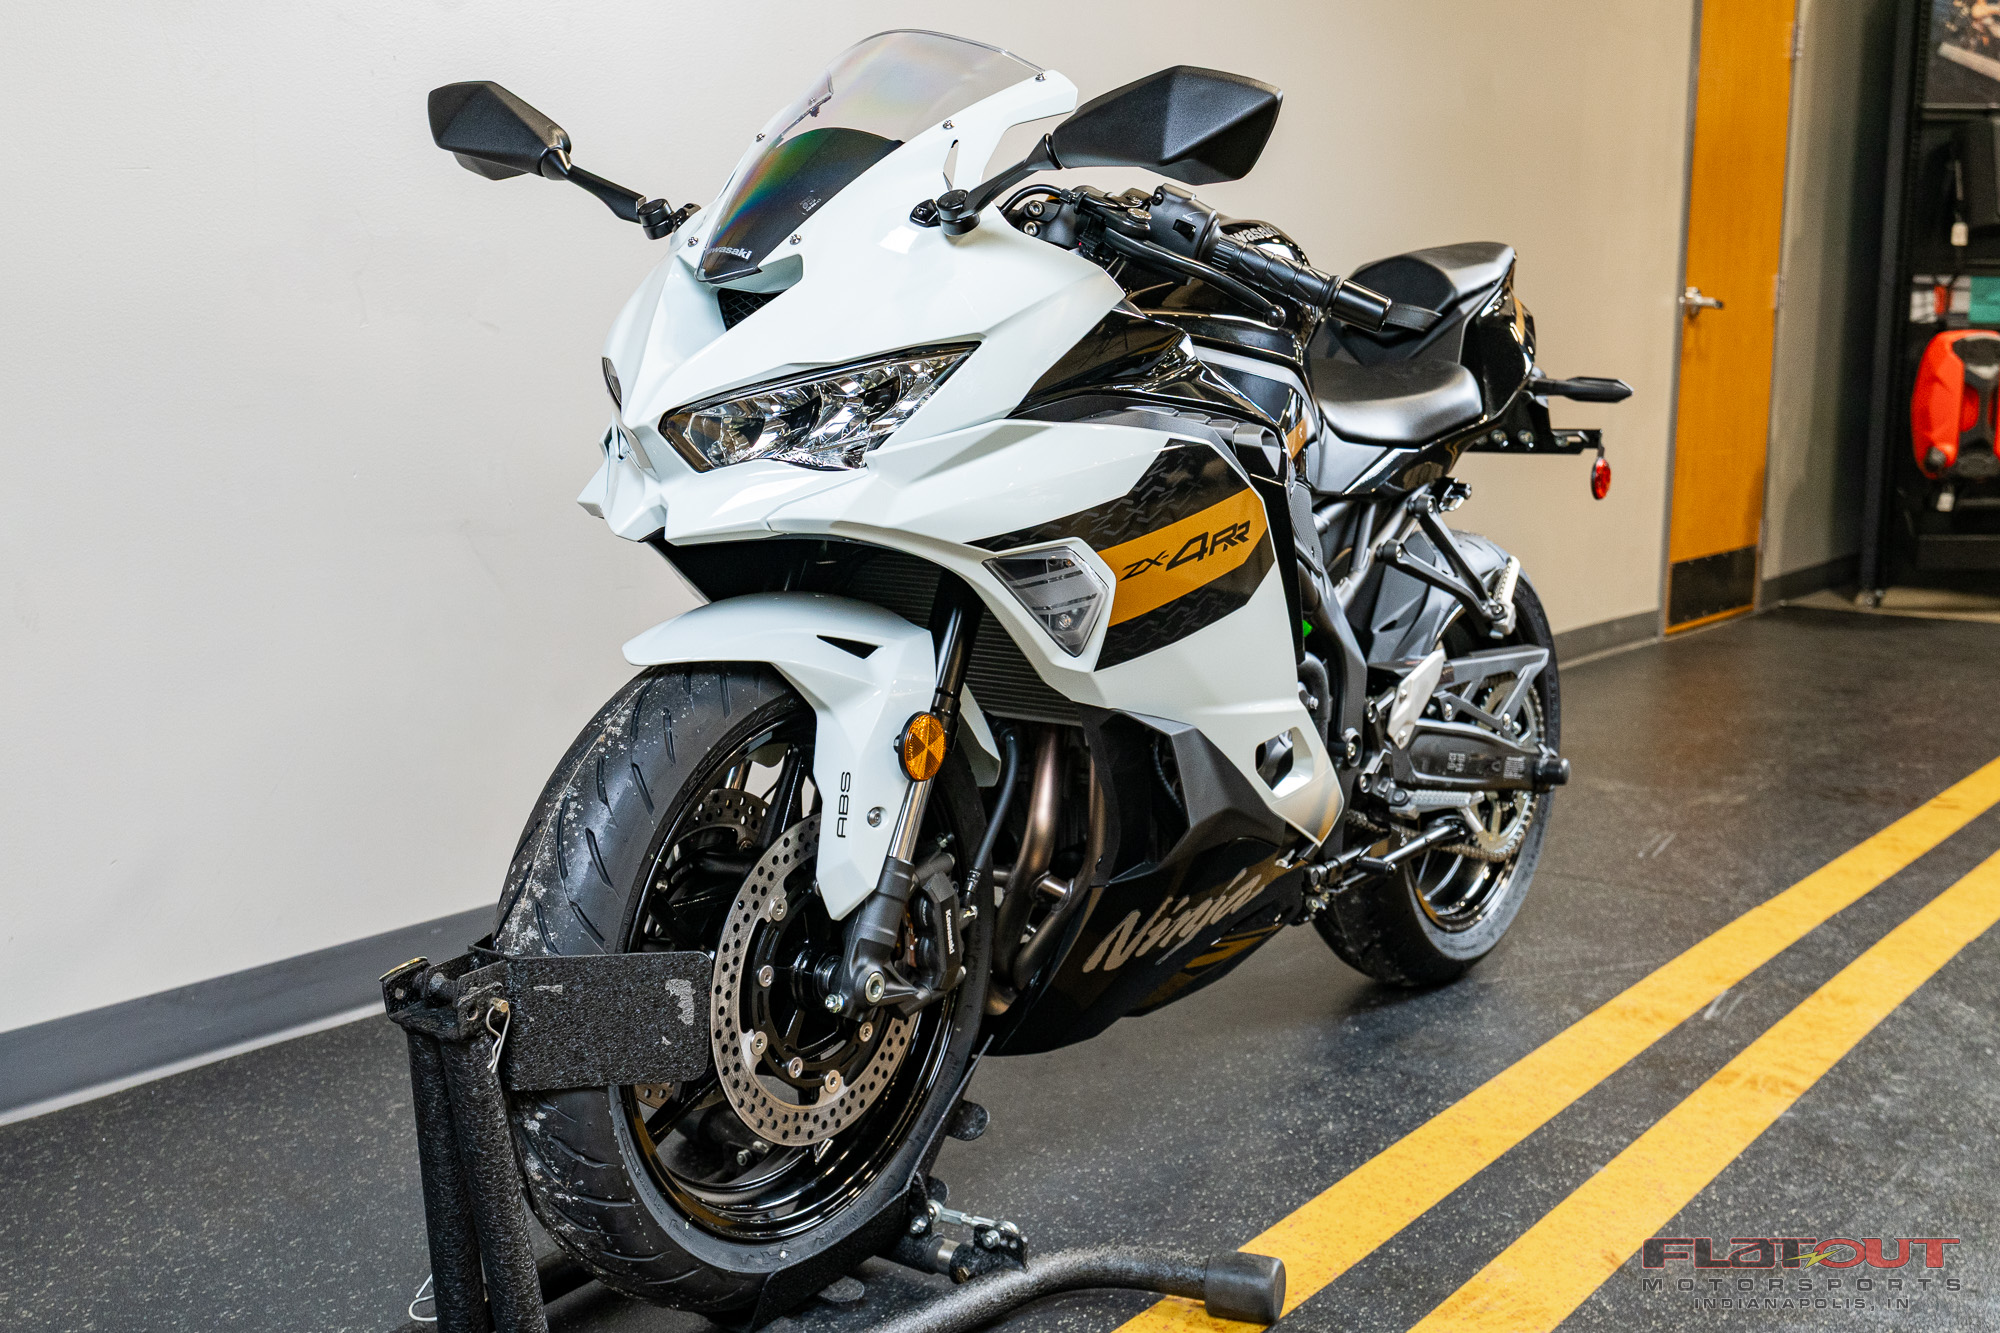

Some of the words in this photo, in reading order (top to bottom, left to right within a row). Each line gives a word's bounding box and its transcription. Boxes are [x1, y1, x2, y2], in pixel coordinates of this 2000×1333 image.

[836, 771, 852, 839] ABS
[945, 908, 956, 955] Kawasaki
[1082, 867, 1265, 974] Ninja
